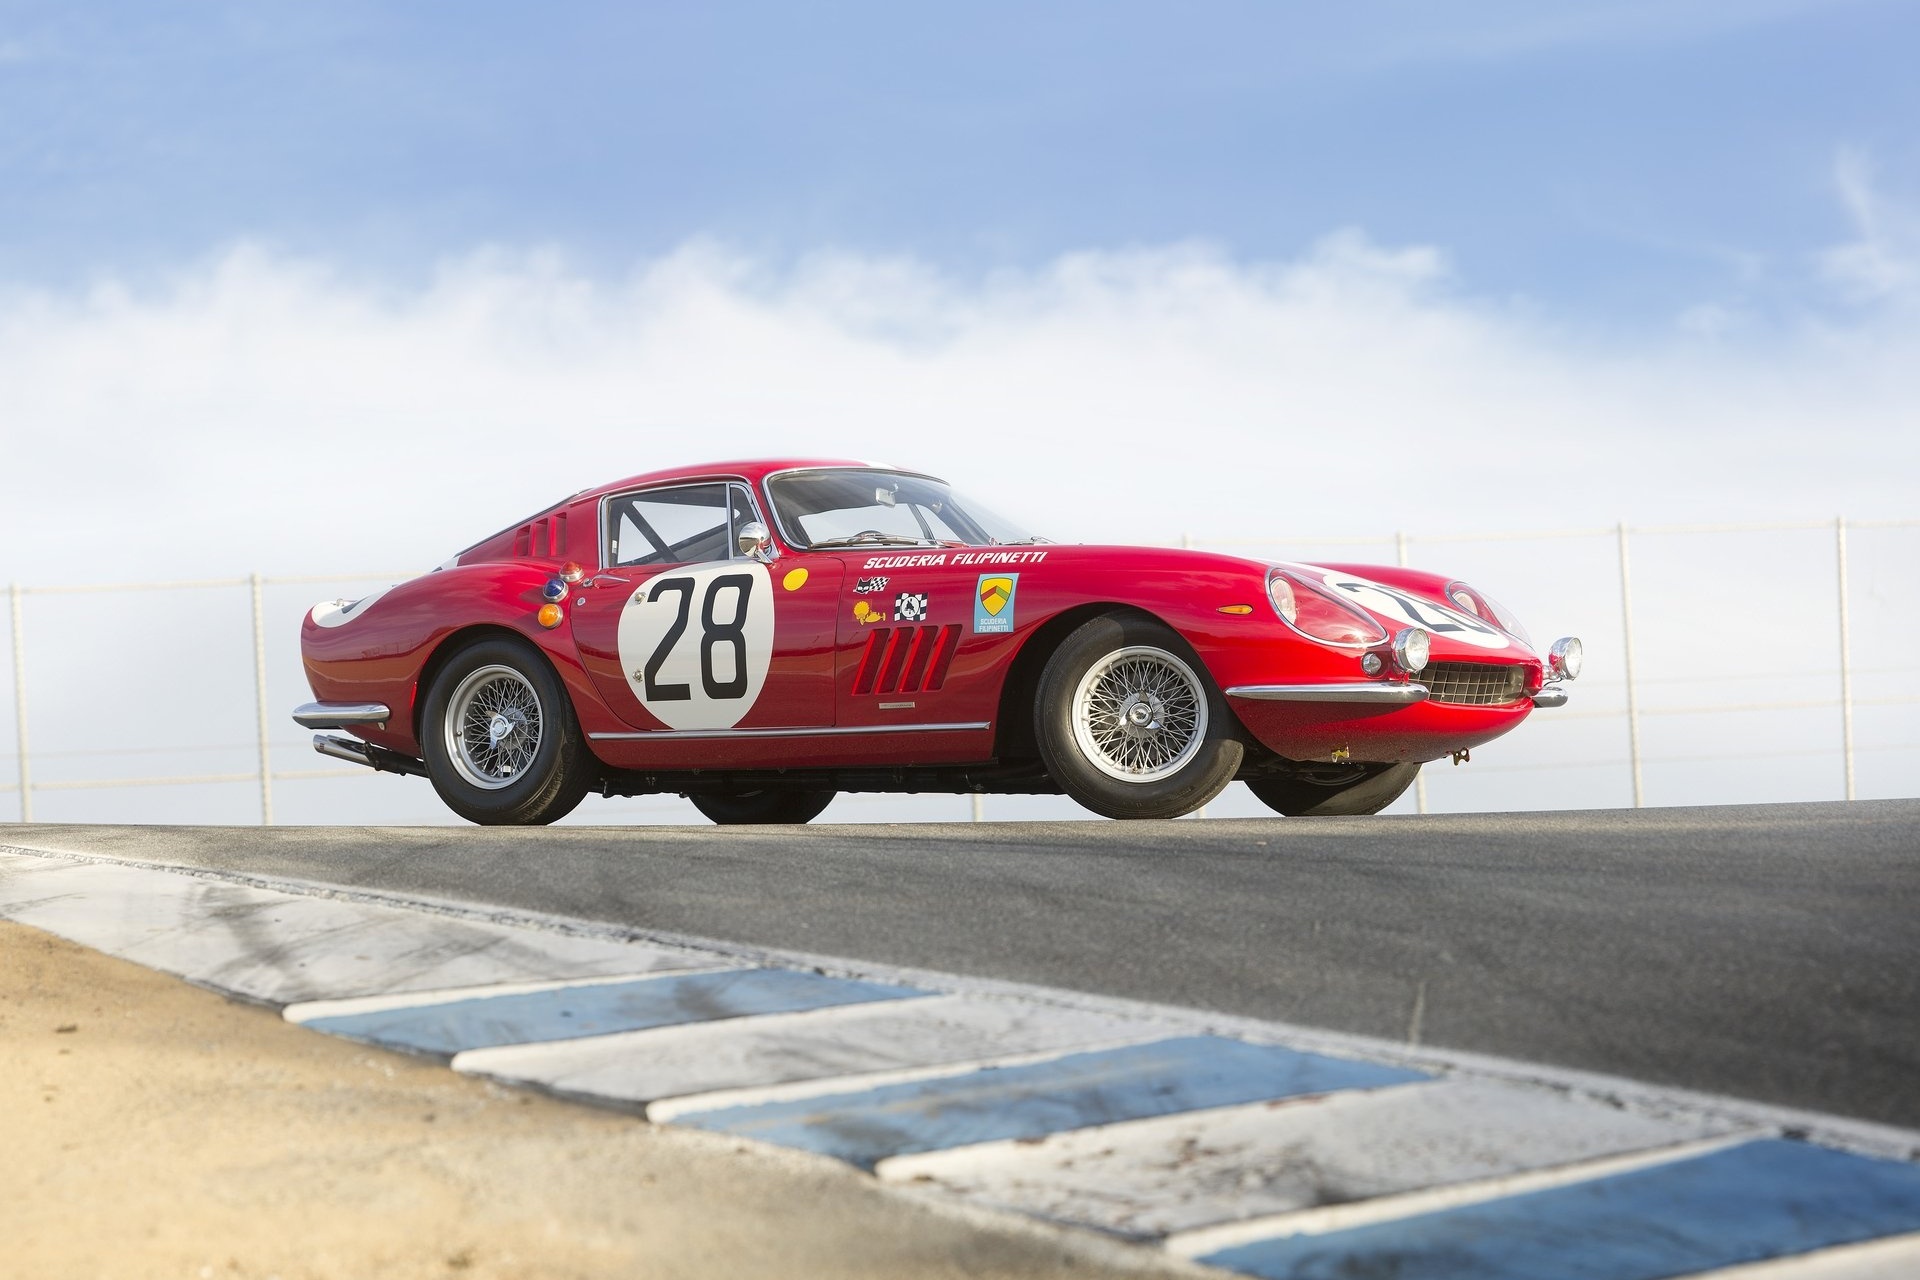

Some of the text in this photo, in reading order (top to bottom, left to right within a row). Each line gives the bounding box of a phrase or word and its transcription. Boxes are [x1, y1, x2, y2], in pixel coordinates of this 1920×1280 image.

[863, 552, 1048, 569] SCUDERIA FILIPINETTI
[644, 574, 753, 701] 28
